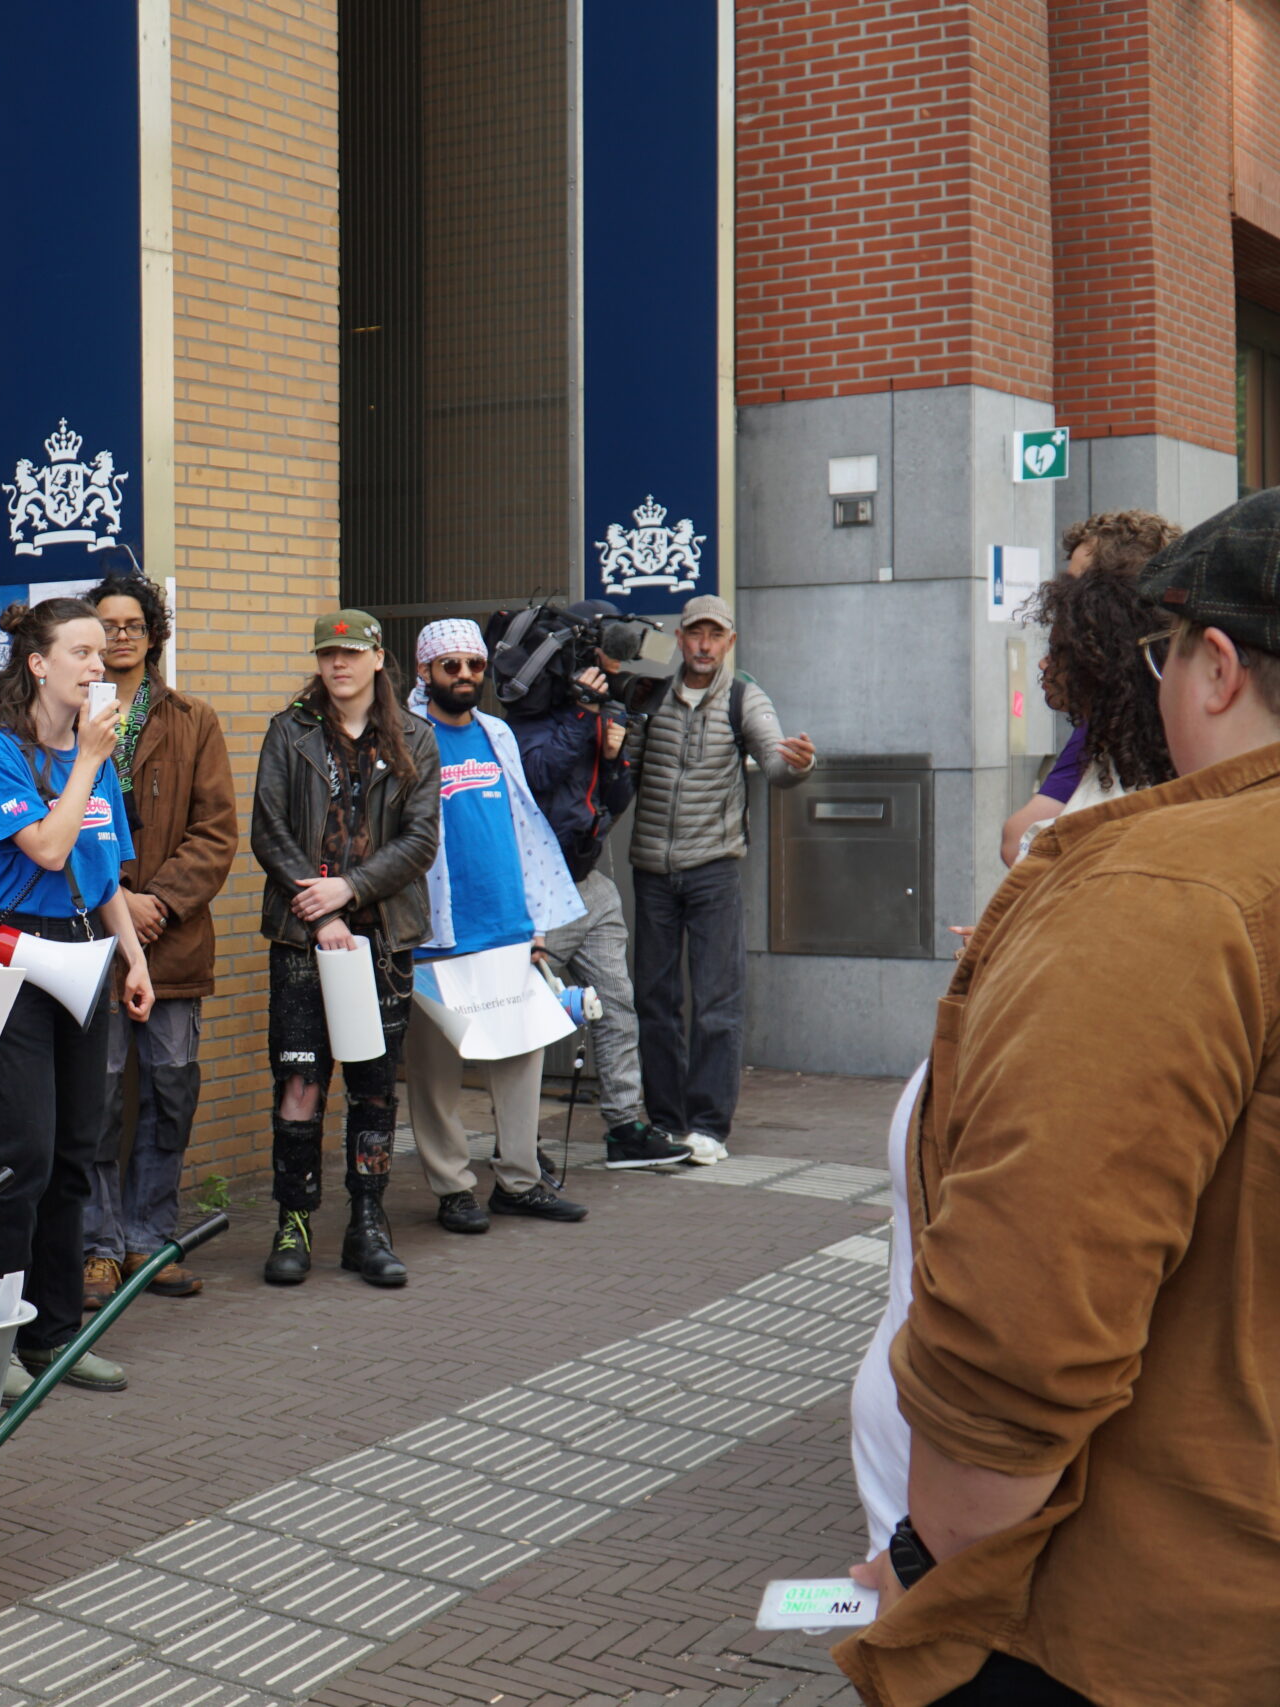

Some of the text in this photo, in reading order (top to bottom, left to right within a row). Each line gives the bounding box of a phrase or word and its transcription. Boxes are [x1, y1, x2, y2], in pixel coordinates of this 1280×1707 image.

[1, 798, 18, 815] FNV
[506, 994, 522, 1005] van
[830, 1600, 861, 1614] FNV
